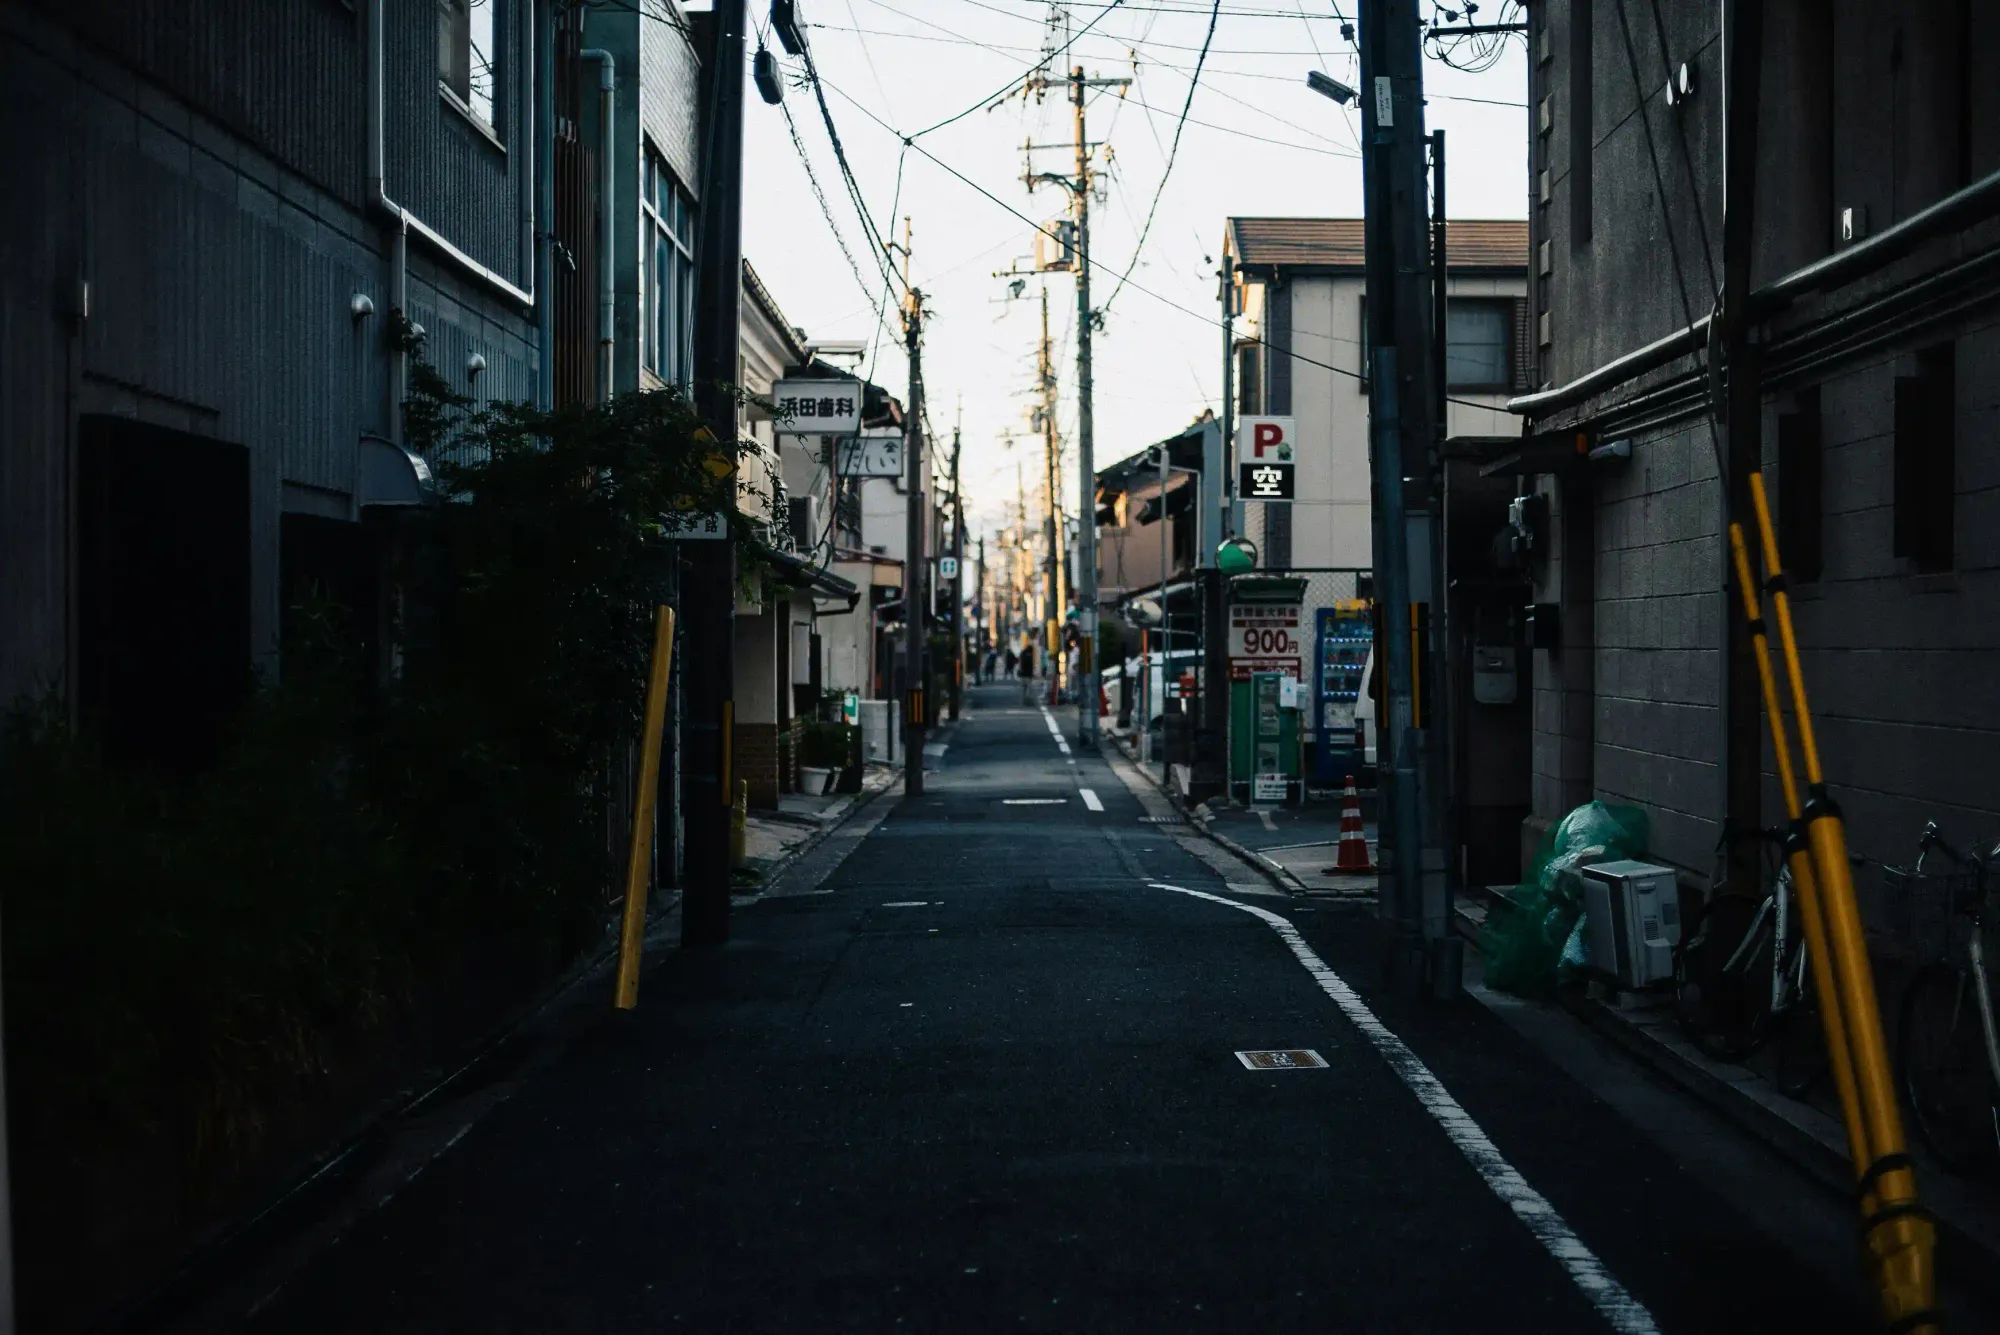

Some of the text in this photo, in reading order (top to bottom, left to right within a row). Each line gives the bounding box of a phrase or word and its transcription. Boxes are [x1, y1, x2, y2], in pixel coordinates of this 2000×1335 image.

[779, 396, 854, 418] 浜田歯科
[1254, 423, 1283, 457] P
[1252, 465, 1282, 496] 空
[1244, 628, 1298, 654] 900円
